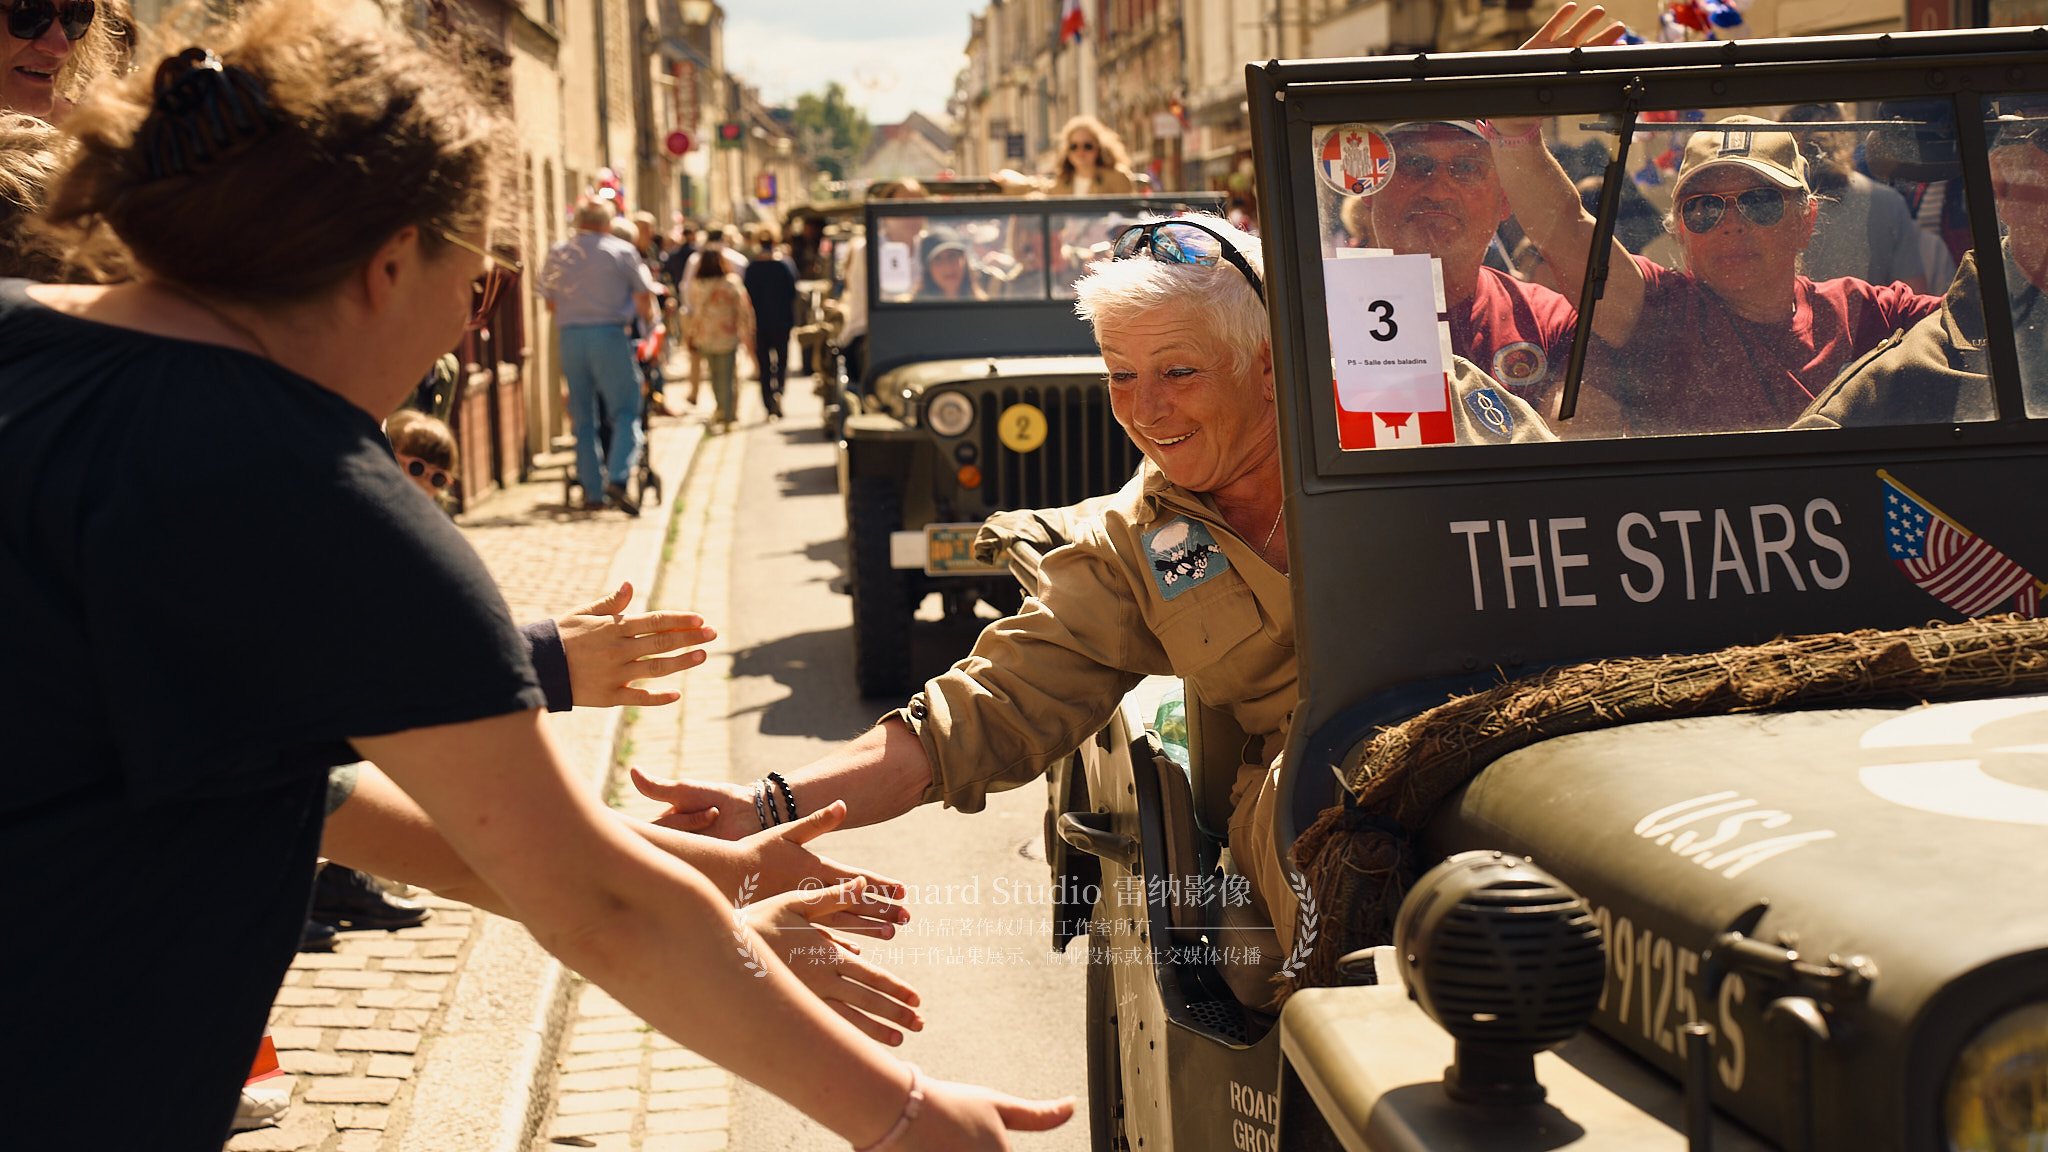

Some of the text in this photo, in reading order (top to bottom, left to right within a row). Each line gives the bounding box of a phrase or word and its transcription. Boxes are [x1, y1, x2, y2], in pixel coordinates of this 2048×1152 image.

[1367, 299, 1399, 342] 3
[1397, 357, 1428, 366] baladins
[1015, 414, 1032, 440] 2
[1449, 497, 1851, 611] THE STARS
